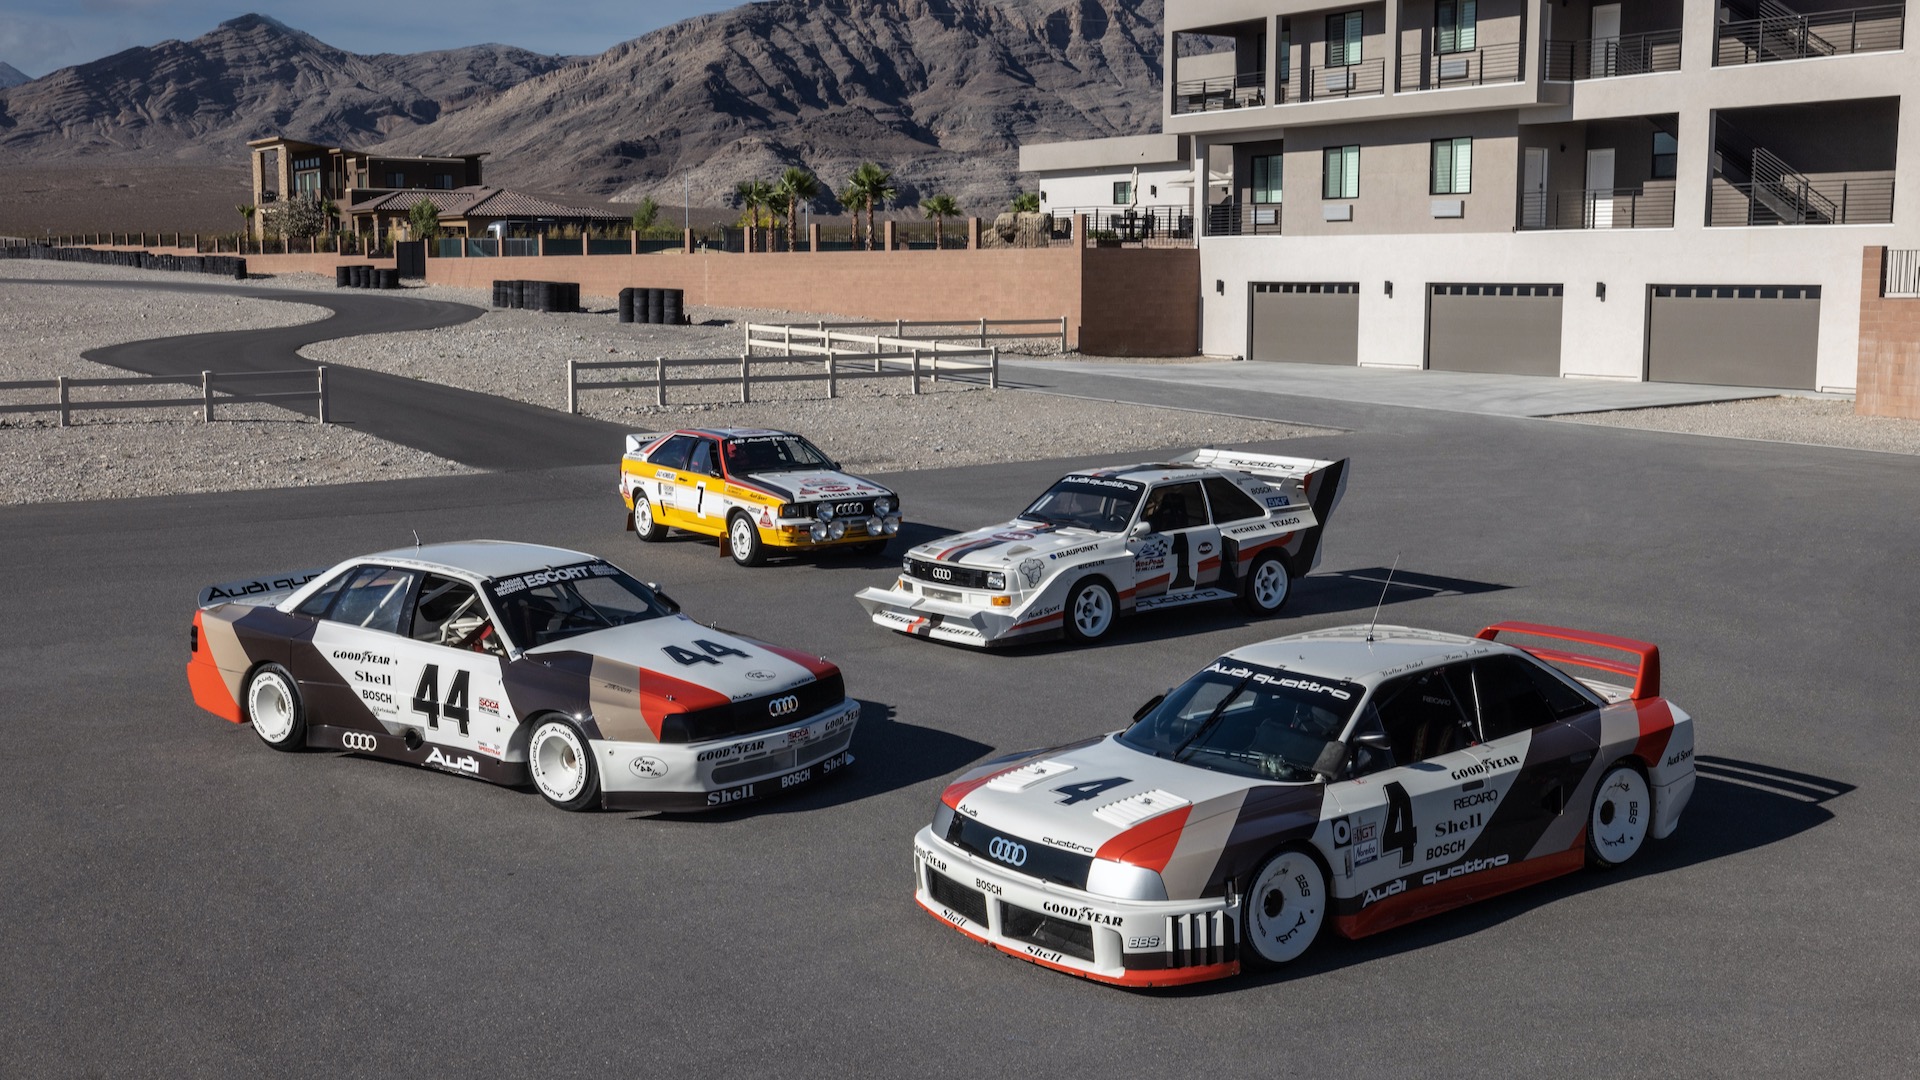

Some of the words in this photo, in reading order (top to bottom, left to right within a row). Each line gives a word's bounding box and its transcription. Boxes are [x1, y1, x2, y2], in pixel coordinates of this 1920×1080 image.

[1229, 460, 1295, 470] quattro
[1090, 479, 1139, 491] quattro
[1251, 486, 1273, 496] BOSCH
[697, 485, 704, 514] 7
[820, 491, 867, 499] MICHELIN
[1267, 496, 1288, 507] SKF
[1231, 523, 1267, 535] MICHELIN
[1270, 517, 1301, 528] TEXACO
[1057, 544, 1099, 559] BLAUPUNKT
[1169, 532, 1196, 590] 1
[1078, 560, 1105, 570] MICHELIN
[523, 566, 589, 588] ESCORT
[207, 581, 271, 602] Audi
[1136, 591, 1218, 608] quattro
[1028, 610, 1043, 619] Audi
[1044, 604, 1060, 616] Sport
[660, 639, 754, 667] 44
[355, 670, 392, 686] Shell
[1203, 662, 1253, 679] Audi
[1253, 672, 1351, 700] quattro
[362, 689, 392, 704] BOSCH
[409, 663, 470, 738] 44
[479, 697, 499, 710] SCCA
[550, 725, 573, 742] Audi
[425, 746, 480, 774] Audi
[532, 729, 547, 777] quattro
[824, 751, 848, 774] Shell
[1666, 755, 1680, 768] Audi
[781, 768, 811, 788] BOSCH
[541, 782, 564, 799] Audi
[707, 784, 755, 806] Shell
[1048, 776, 1135, 807] 4
[1453, 790, 1499, 811] RECARO
[957, 803, 978, 818] Audi
[1628, 801, 1638, 825] BBS
[1381, 780, 1417, 868] 4
[1435, 813, 1483, 838] Shell
[1041, 835, 1093, 854] quattro
[1426, 839, 1466, 861] BOSCH
[975, 877, 1002, 896] BOSCH
[1295, 874, 1311, 897] BBS
[1362, 877, 1408, 908] Audi
[1422, 853, 1510, 885] quattro
[940, 908, 967, 927] Shell
[1128, 936, 1159, 948] BBS
[1024, 944, 1063, 963] Shell
